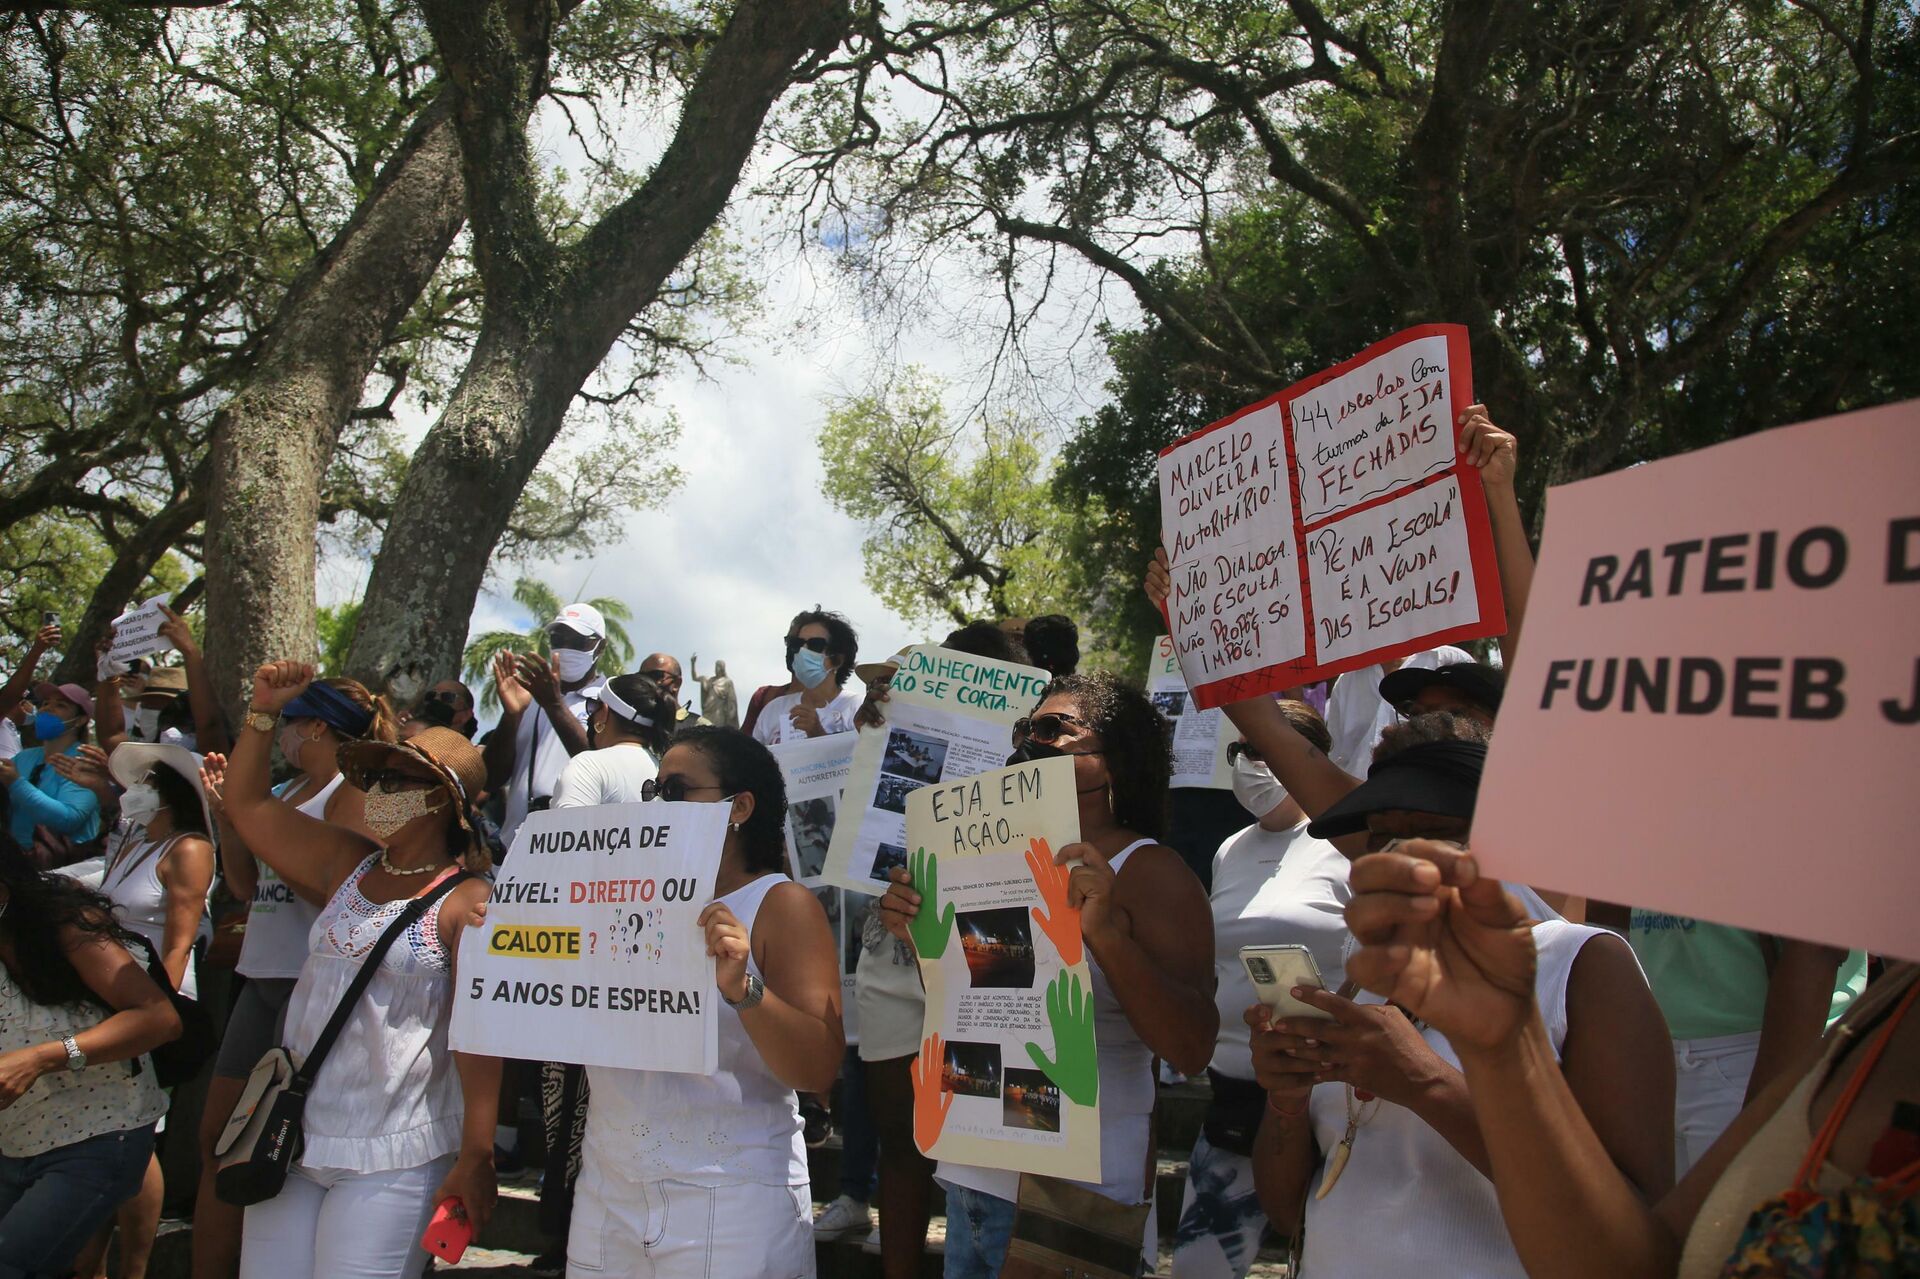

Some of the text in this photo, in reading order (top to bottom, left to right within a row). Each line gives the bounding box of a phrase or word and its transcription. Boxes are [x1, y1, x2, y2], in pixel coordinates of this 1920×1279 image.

[1301, 400, 1333, 433] 44
[1337, 372, 1405, 424] escolas
[1398, 379, 1444, 424] EJA
[1171, 431, 1252, 497] MARCELO
[1267, 439, 1279, 469] É
[1317, 413, 1438, 506] FECHADAS
[1341, 544, 1438, 601] É A VENDA
[1351, 535, 1374, 567] NA
[1577, 525, 1850, 607] RATEIO
[1176, 560, 1208, 608] NÃO
[1178, 597, 1206, 634] NÃO
[1179, 631, 1205, 658] NÃO
[1268, 593, 1290, 625] SÓ
[1320, 570, 1460, 649] DAS ESCOLAS!
[890, 673, 916, 692] ÃO
[922, 680, 949, 699] SE
[1539, 656, 1848, 721] FUNDEB
[798, 768, 851, 785] AUTORRETRATO
[932, 767, 1042, 823] EJA EM
[529, 825, 671, 856] MUDANÇA DE
[953, 811, 1024, 855] AÇÃO...
[489, 875, 697, 904] NÍVEL: DIREITO OU
[491, 929, 581, 955] CALOTE
[470, 977, 701, 1016] 5 ANOS DE ESPERA!
